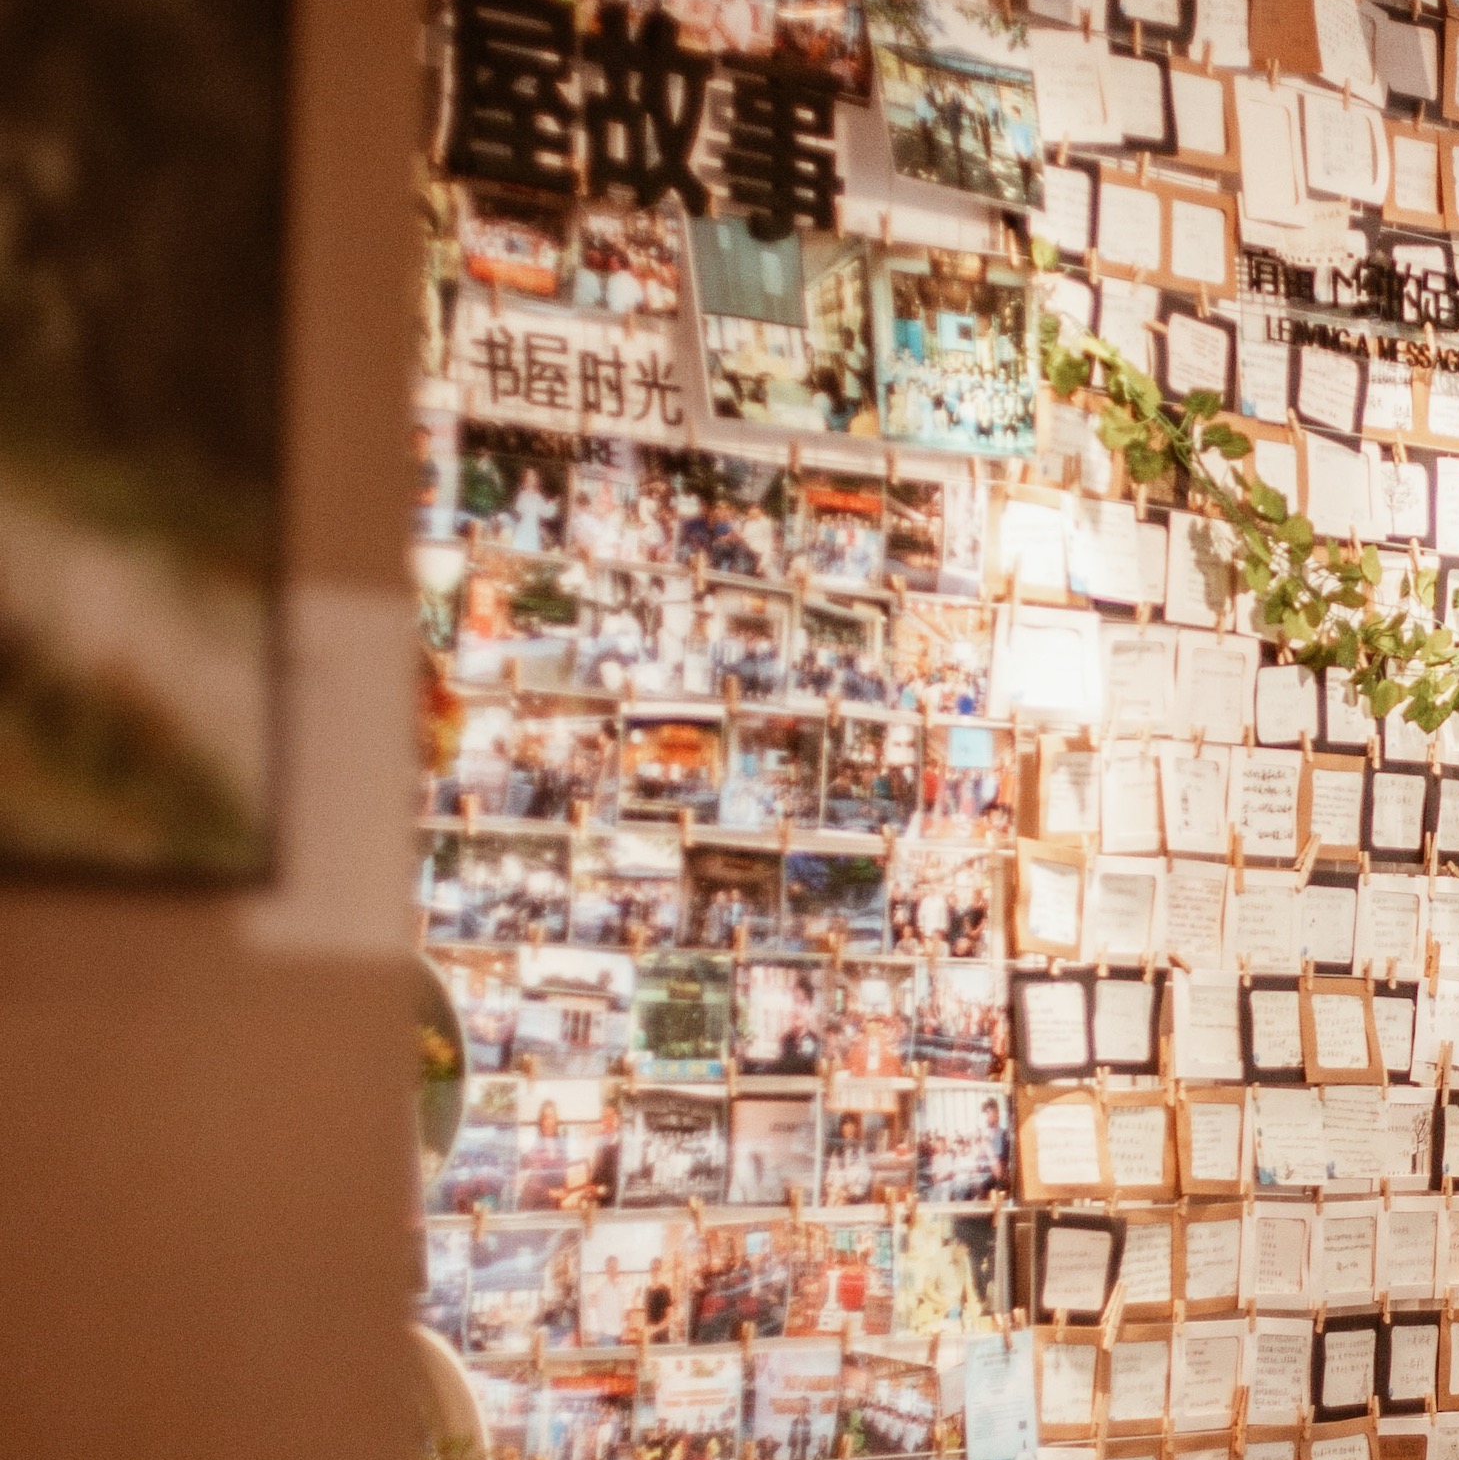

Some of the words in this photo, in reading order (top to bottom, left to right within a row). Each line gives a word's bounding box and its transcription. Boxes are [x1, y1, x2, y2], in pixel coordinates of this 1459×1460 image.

[471, 324, 683, 427] 书屋时光
[1354, 331, 1371, 359] A
